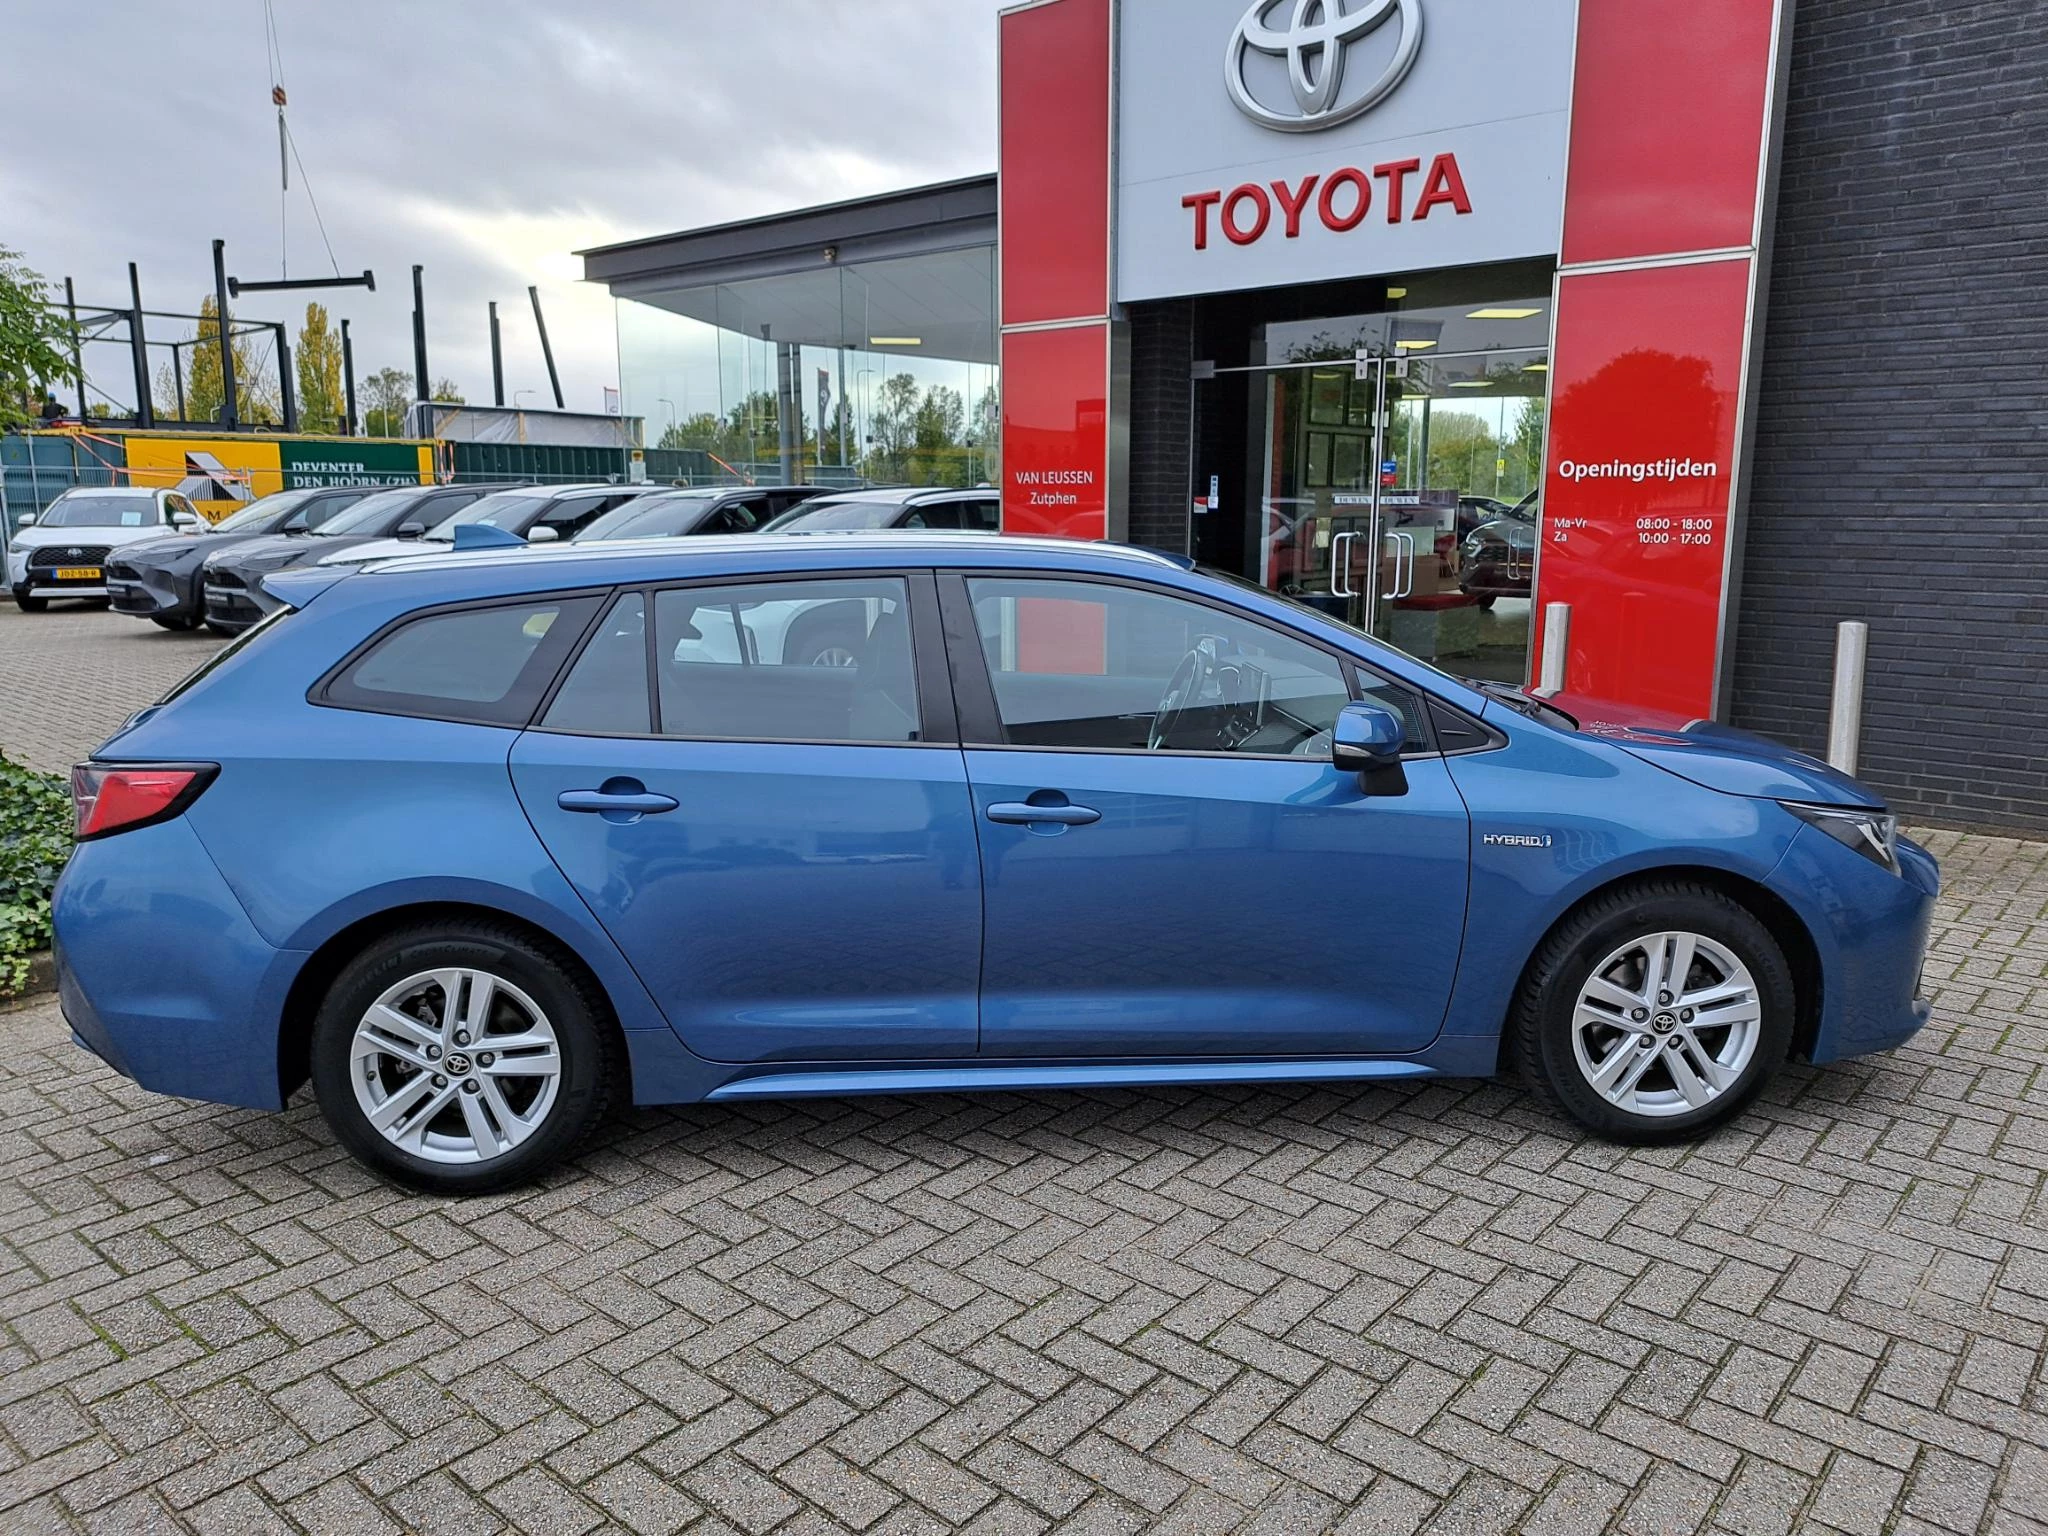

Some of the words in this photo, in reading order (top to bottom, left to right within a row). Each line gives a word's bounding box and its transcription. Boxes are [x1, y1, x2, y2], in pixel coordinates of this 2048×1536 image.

[1182, 152, 1472, 250] TOYOTA
[290, 460, 364, 473] DEVENTER
[1559, 457, 1718, 482] Openingstijden
[292, 475, 324, 489] DEN
[328, 476, 381, 489] HOORN
[1016, 472, 1040, 484] VAN
[1042, 471, 1093, 484] LEUSSEN
[1030, 491, 1077, 507] Zutphen
[1553, 517, 1588, 528] Ma-Vr
[1635, 518, 1670, 530] 08:00
[1681, 518, 1713, 531] 18:00
[1553, 531, 1567, 542] Za
[1637, 532, 1670, 544] 10:00
[1681, 533, 1711, 545] 17:00
[1483, 833, 1542, 848] HYBRID
